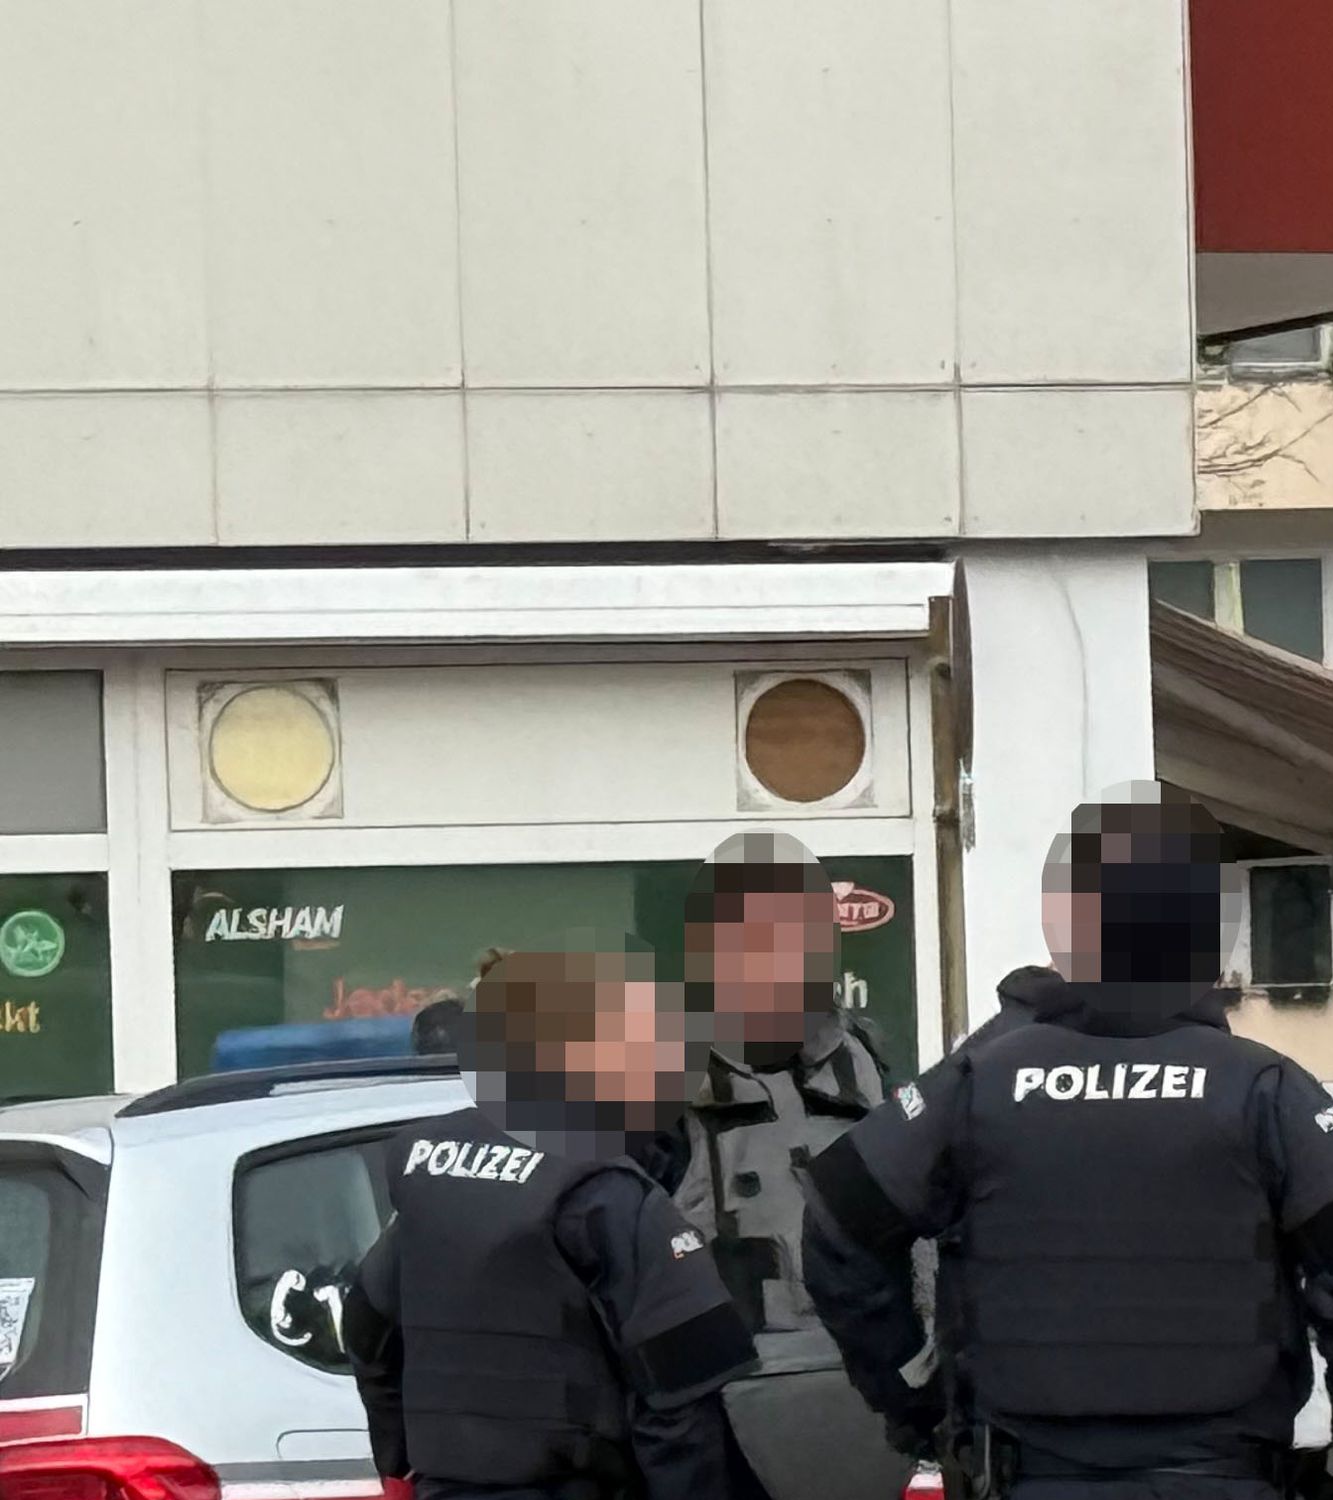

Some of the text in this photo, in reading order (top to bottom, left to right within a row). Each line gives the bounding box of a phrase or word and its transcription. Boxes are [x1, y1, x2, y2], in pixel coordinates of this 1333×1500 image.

[204, 904, 344, 942] ALSHAM
[1013, 1063, 1207, 1102] POLIZEI
[403, 1139, 545, 1184] POLIZEI
